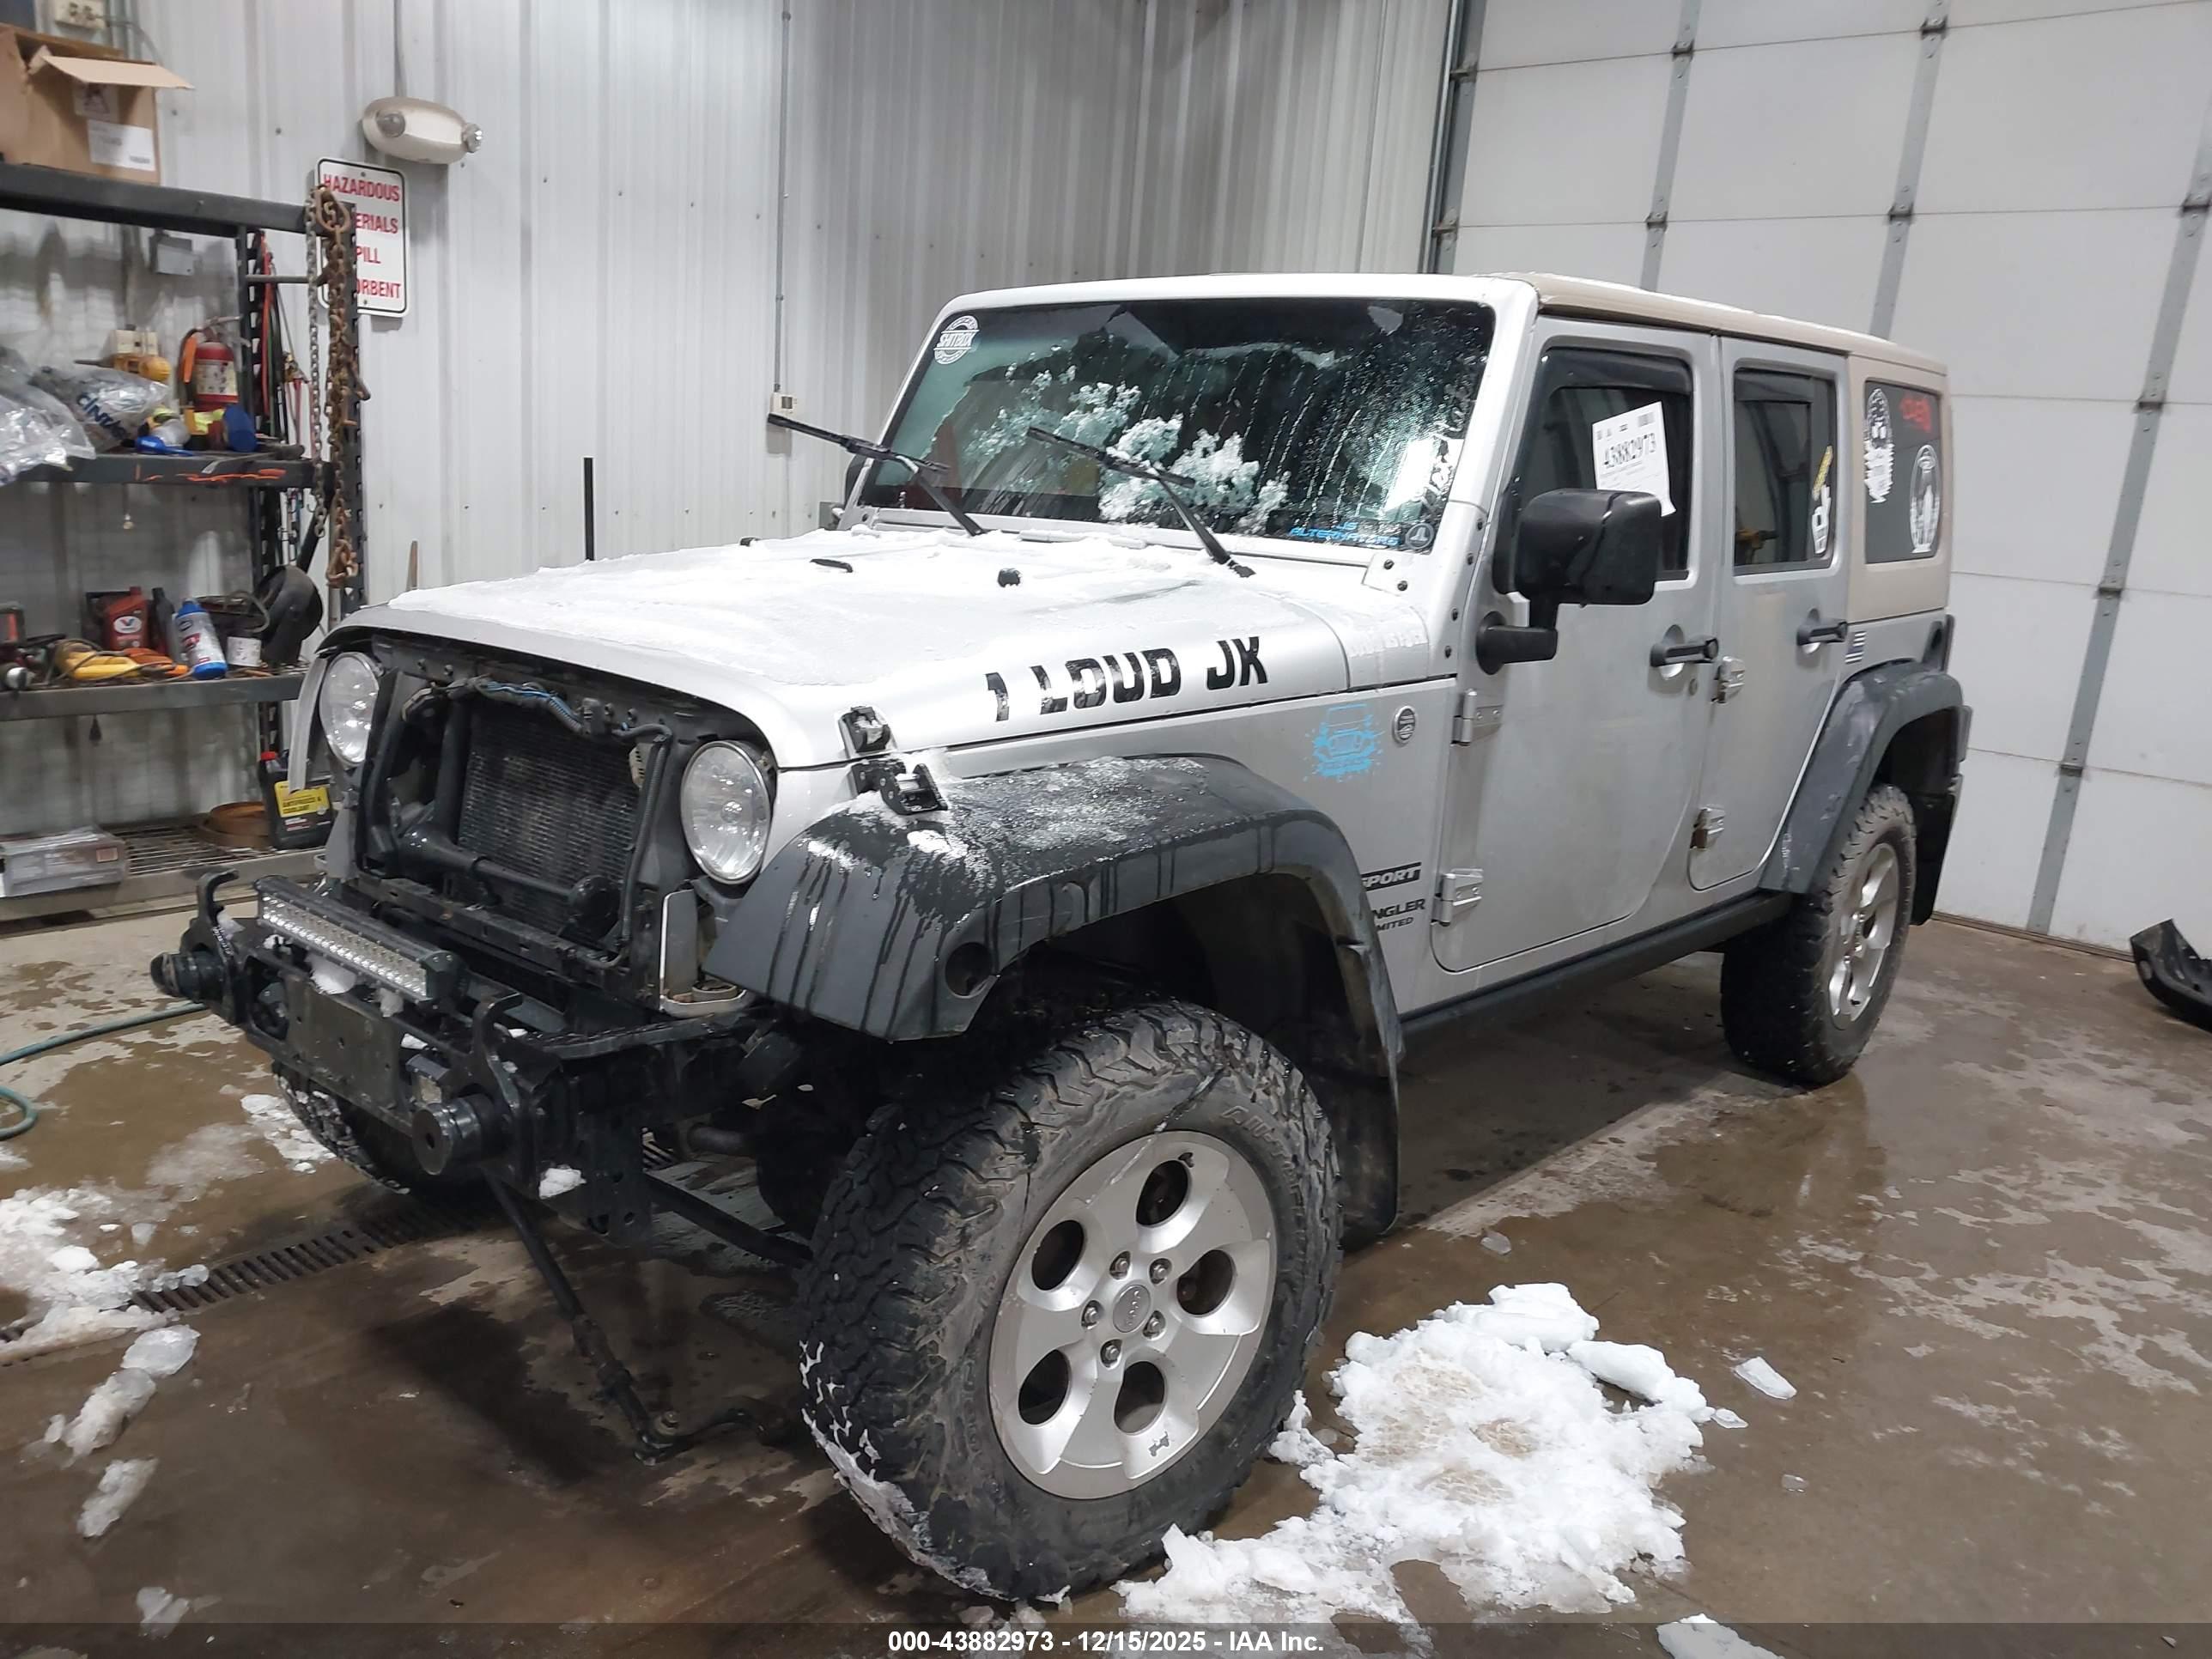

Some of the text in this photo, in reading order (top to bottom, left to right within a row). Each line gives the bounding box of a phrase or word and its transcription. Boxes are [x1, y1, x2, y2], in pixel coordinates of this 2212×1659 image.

[323, 173, 400, 202] HAZARDOUS
[356, 212, 398, 234] ERIALS
[356, 246, 381, 264] PILL
[356, 279, 402, 299] ORBENT
[1603, 432, 1656, 469] 43882973
[985, 636, 1268, 722] 1 LOUD JK
[1371, 898, 1425, 920] NGLER
[1376, 916, 1414, 931] MITED
